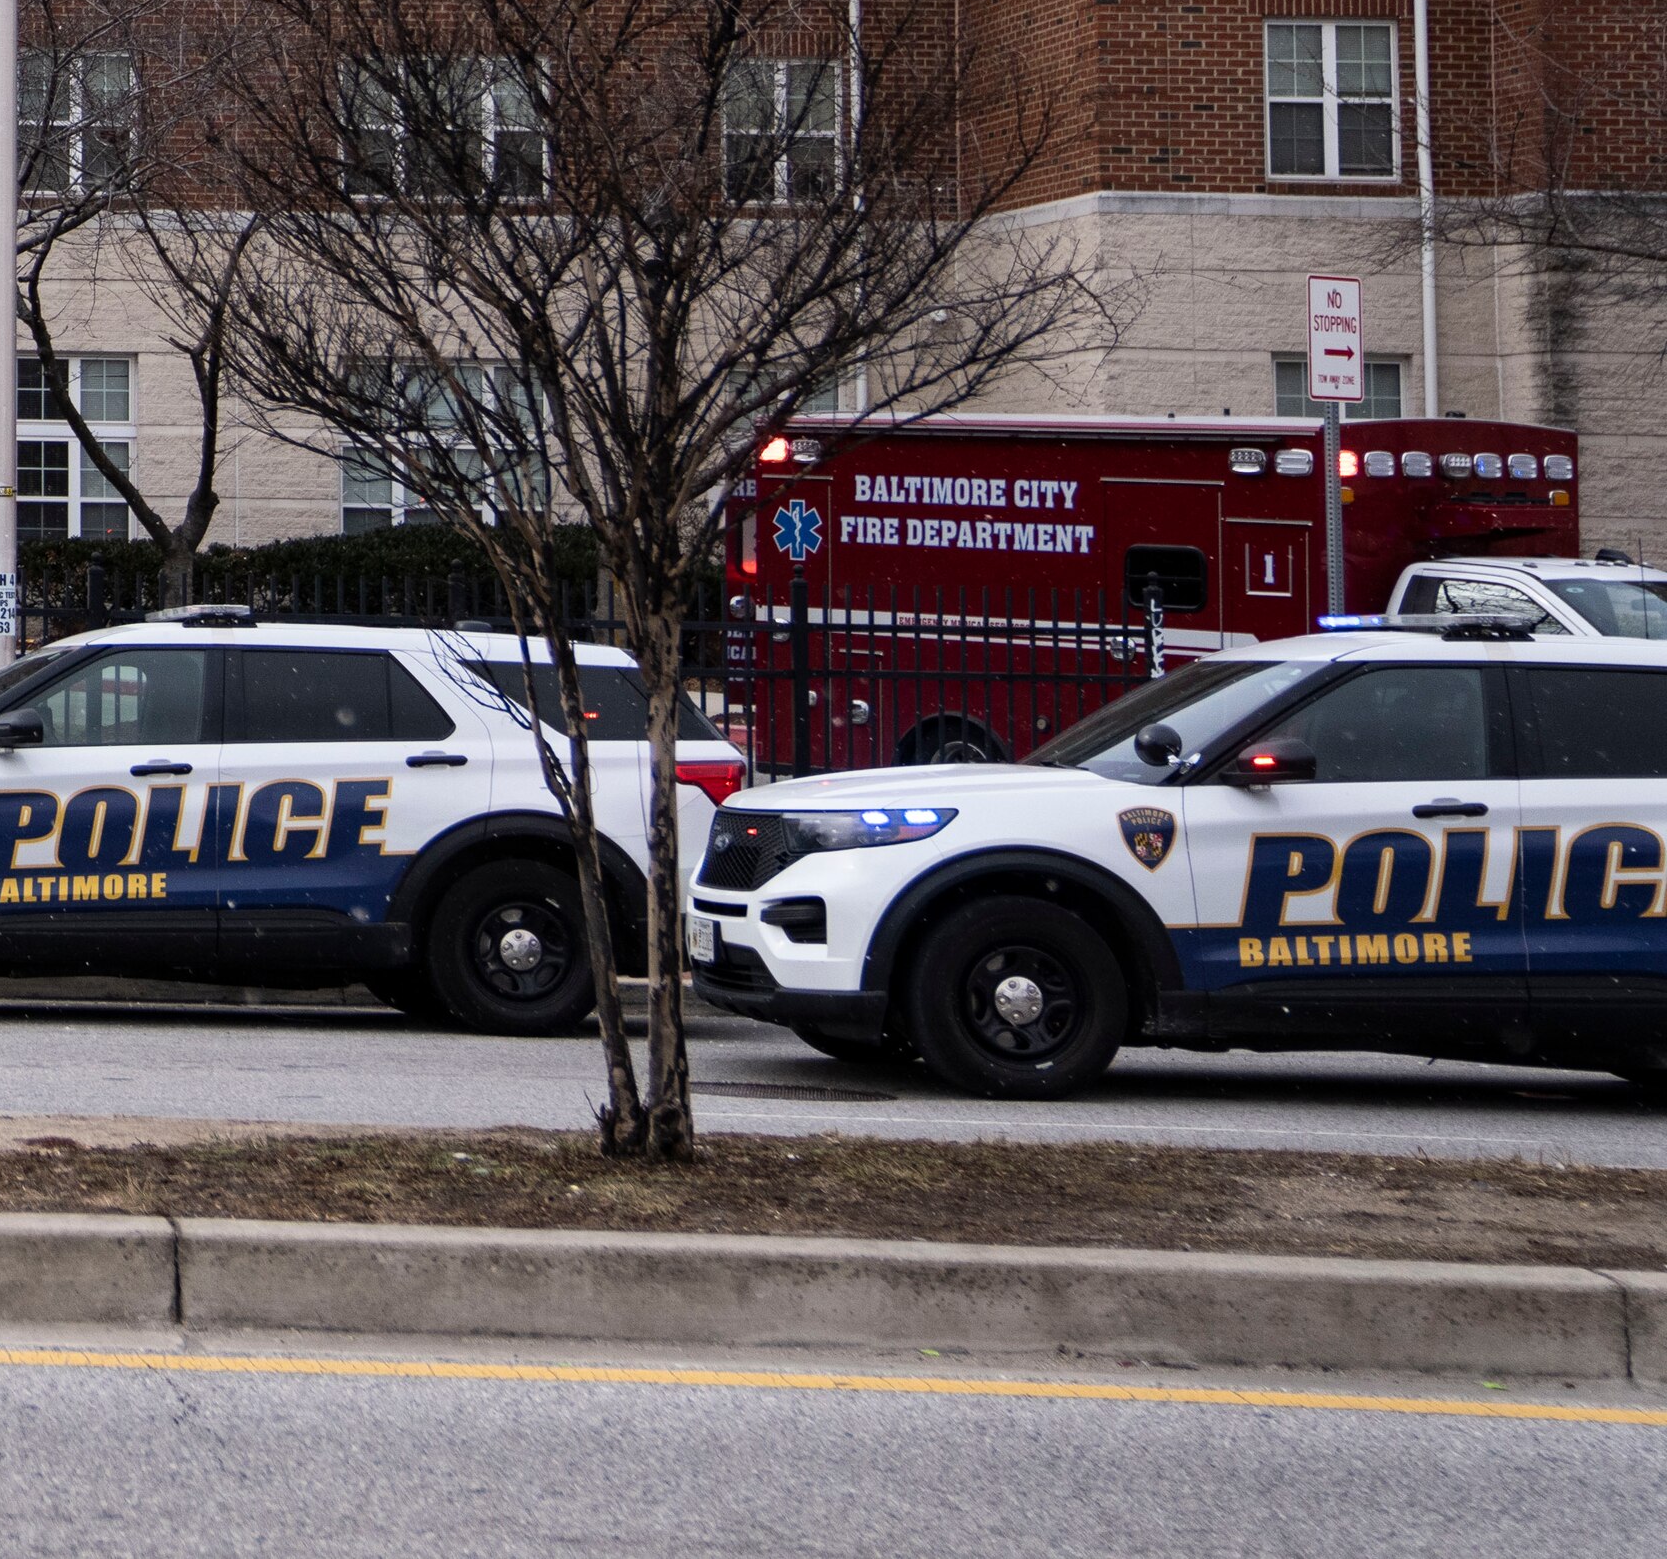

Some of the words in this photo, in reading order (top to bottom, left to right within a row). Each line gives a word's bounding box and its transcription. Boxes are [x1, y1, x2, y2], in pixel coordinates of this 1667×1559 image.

[1327, 291, 1342, 309] NO
[1314, 314, 1357, 334] STOPPING
[854, 475, 1007, 507] BALTIMORE
[1013, 479, 1078, 509] CITY
[839, 516, 900, 545] FIRE
[906, 518, 1094, 554] DEPARTMENT
[9, 573, 15, 586] 4
[1264, 554, 1275, 584] 1
[1121, 809, 1170, 821] BALTIMORE
[1131, 816, 1163, 826] POLICE
[1241, 822, 1667, 926] POLIC
[1239, 932, 1473, 968] BALTIMORE
